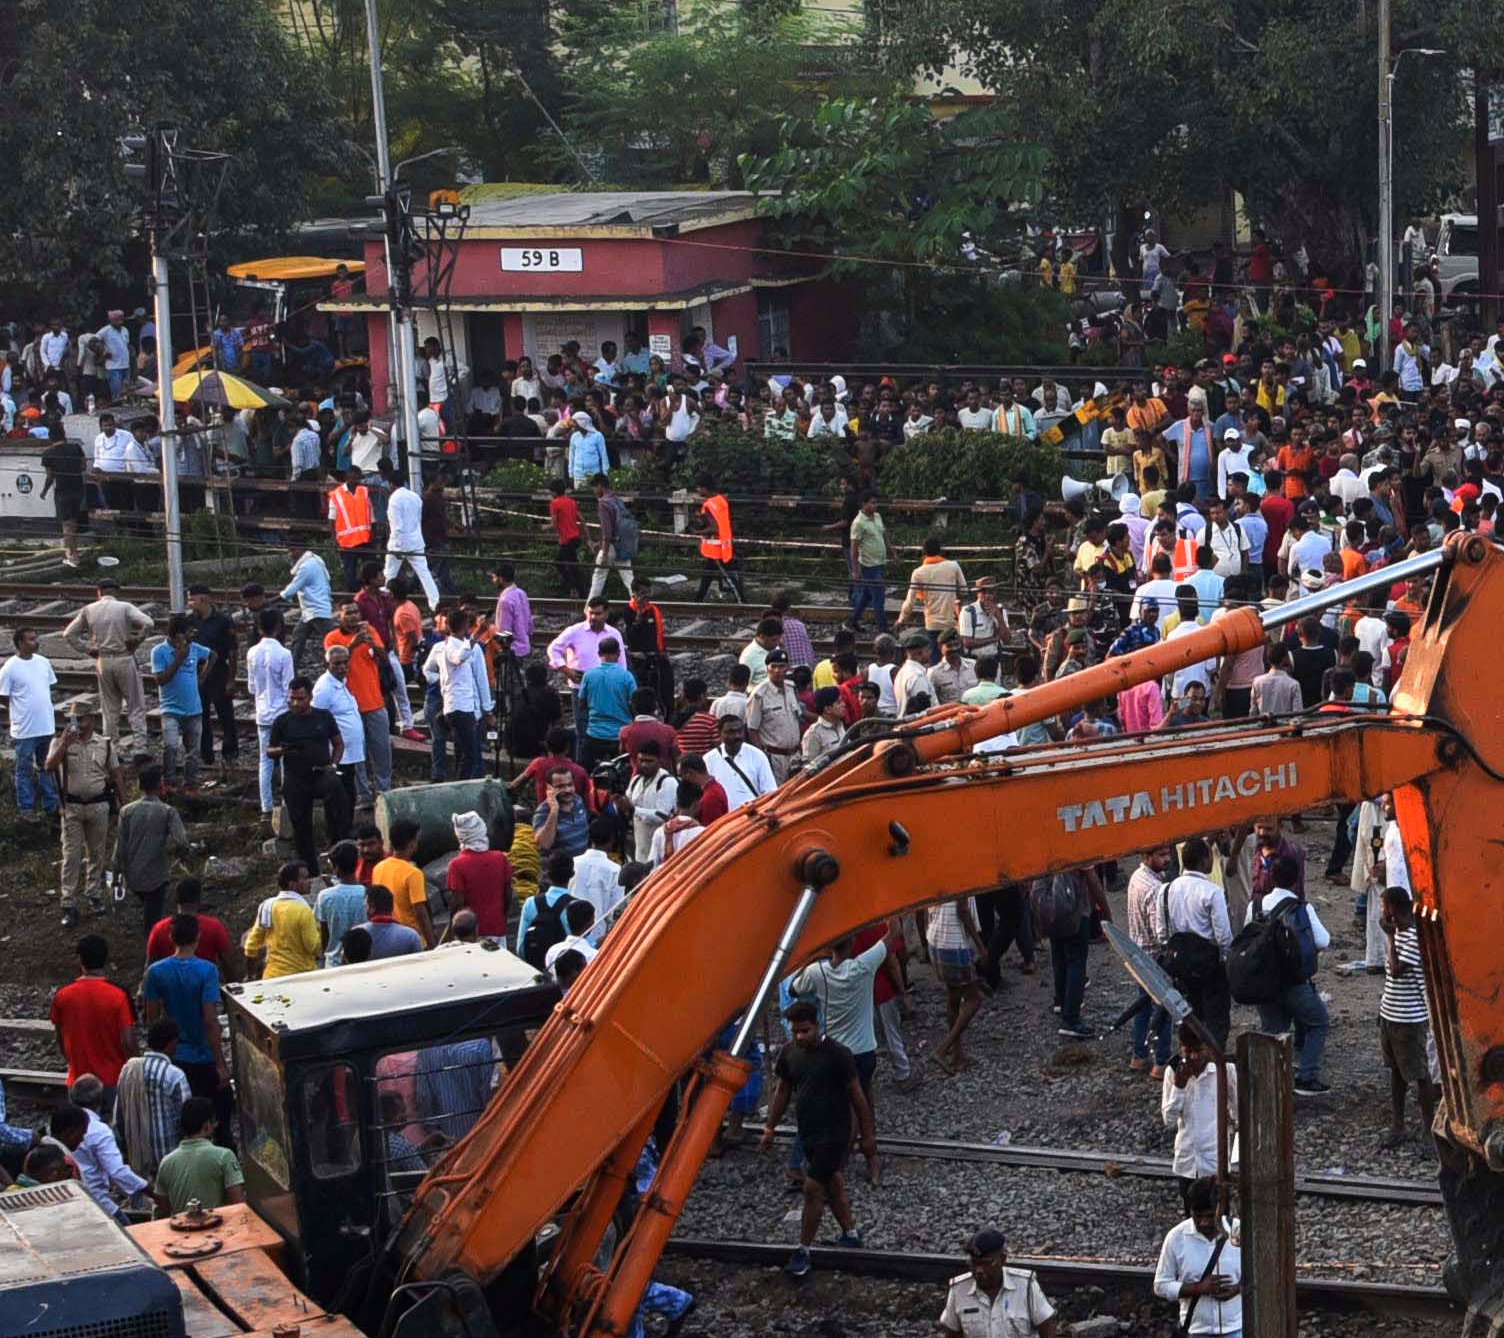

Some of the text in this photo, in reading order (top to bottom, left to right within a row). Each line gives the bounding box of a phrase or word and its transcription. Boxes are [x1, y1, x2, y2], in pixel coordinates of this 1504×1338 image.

[521, 250, 561, 268] 59 B
[1057, 762, 1298, 833] TATA HITACHI
